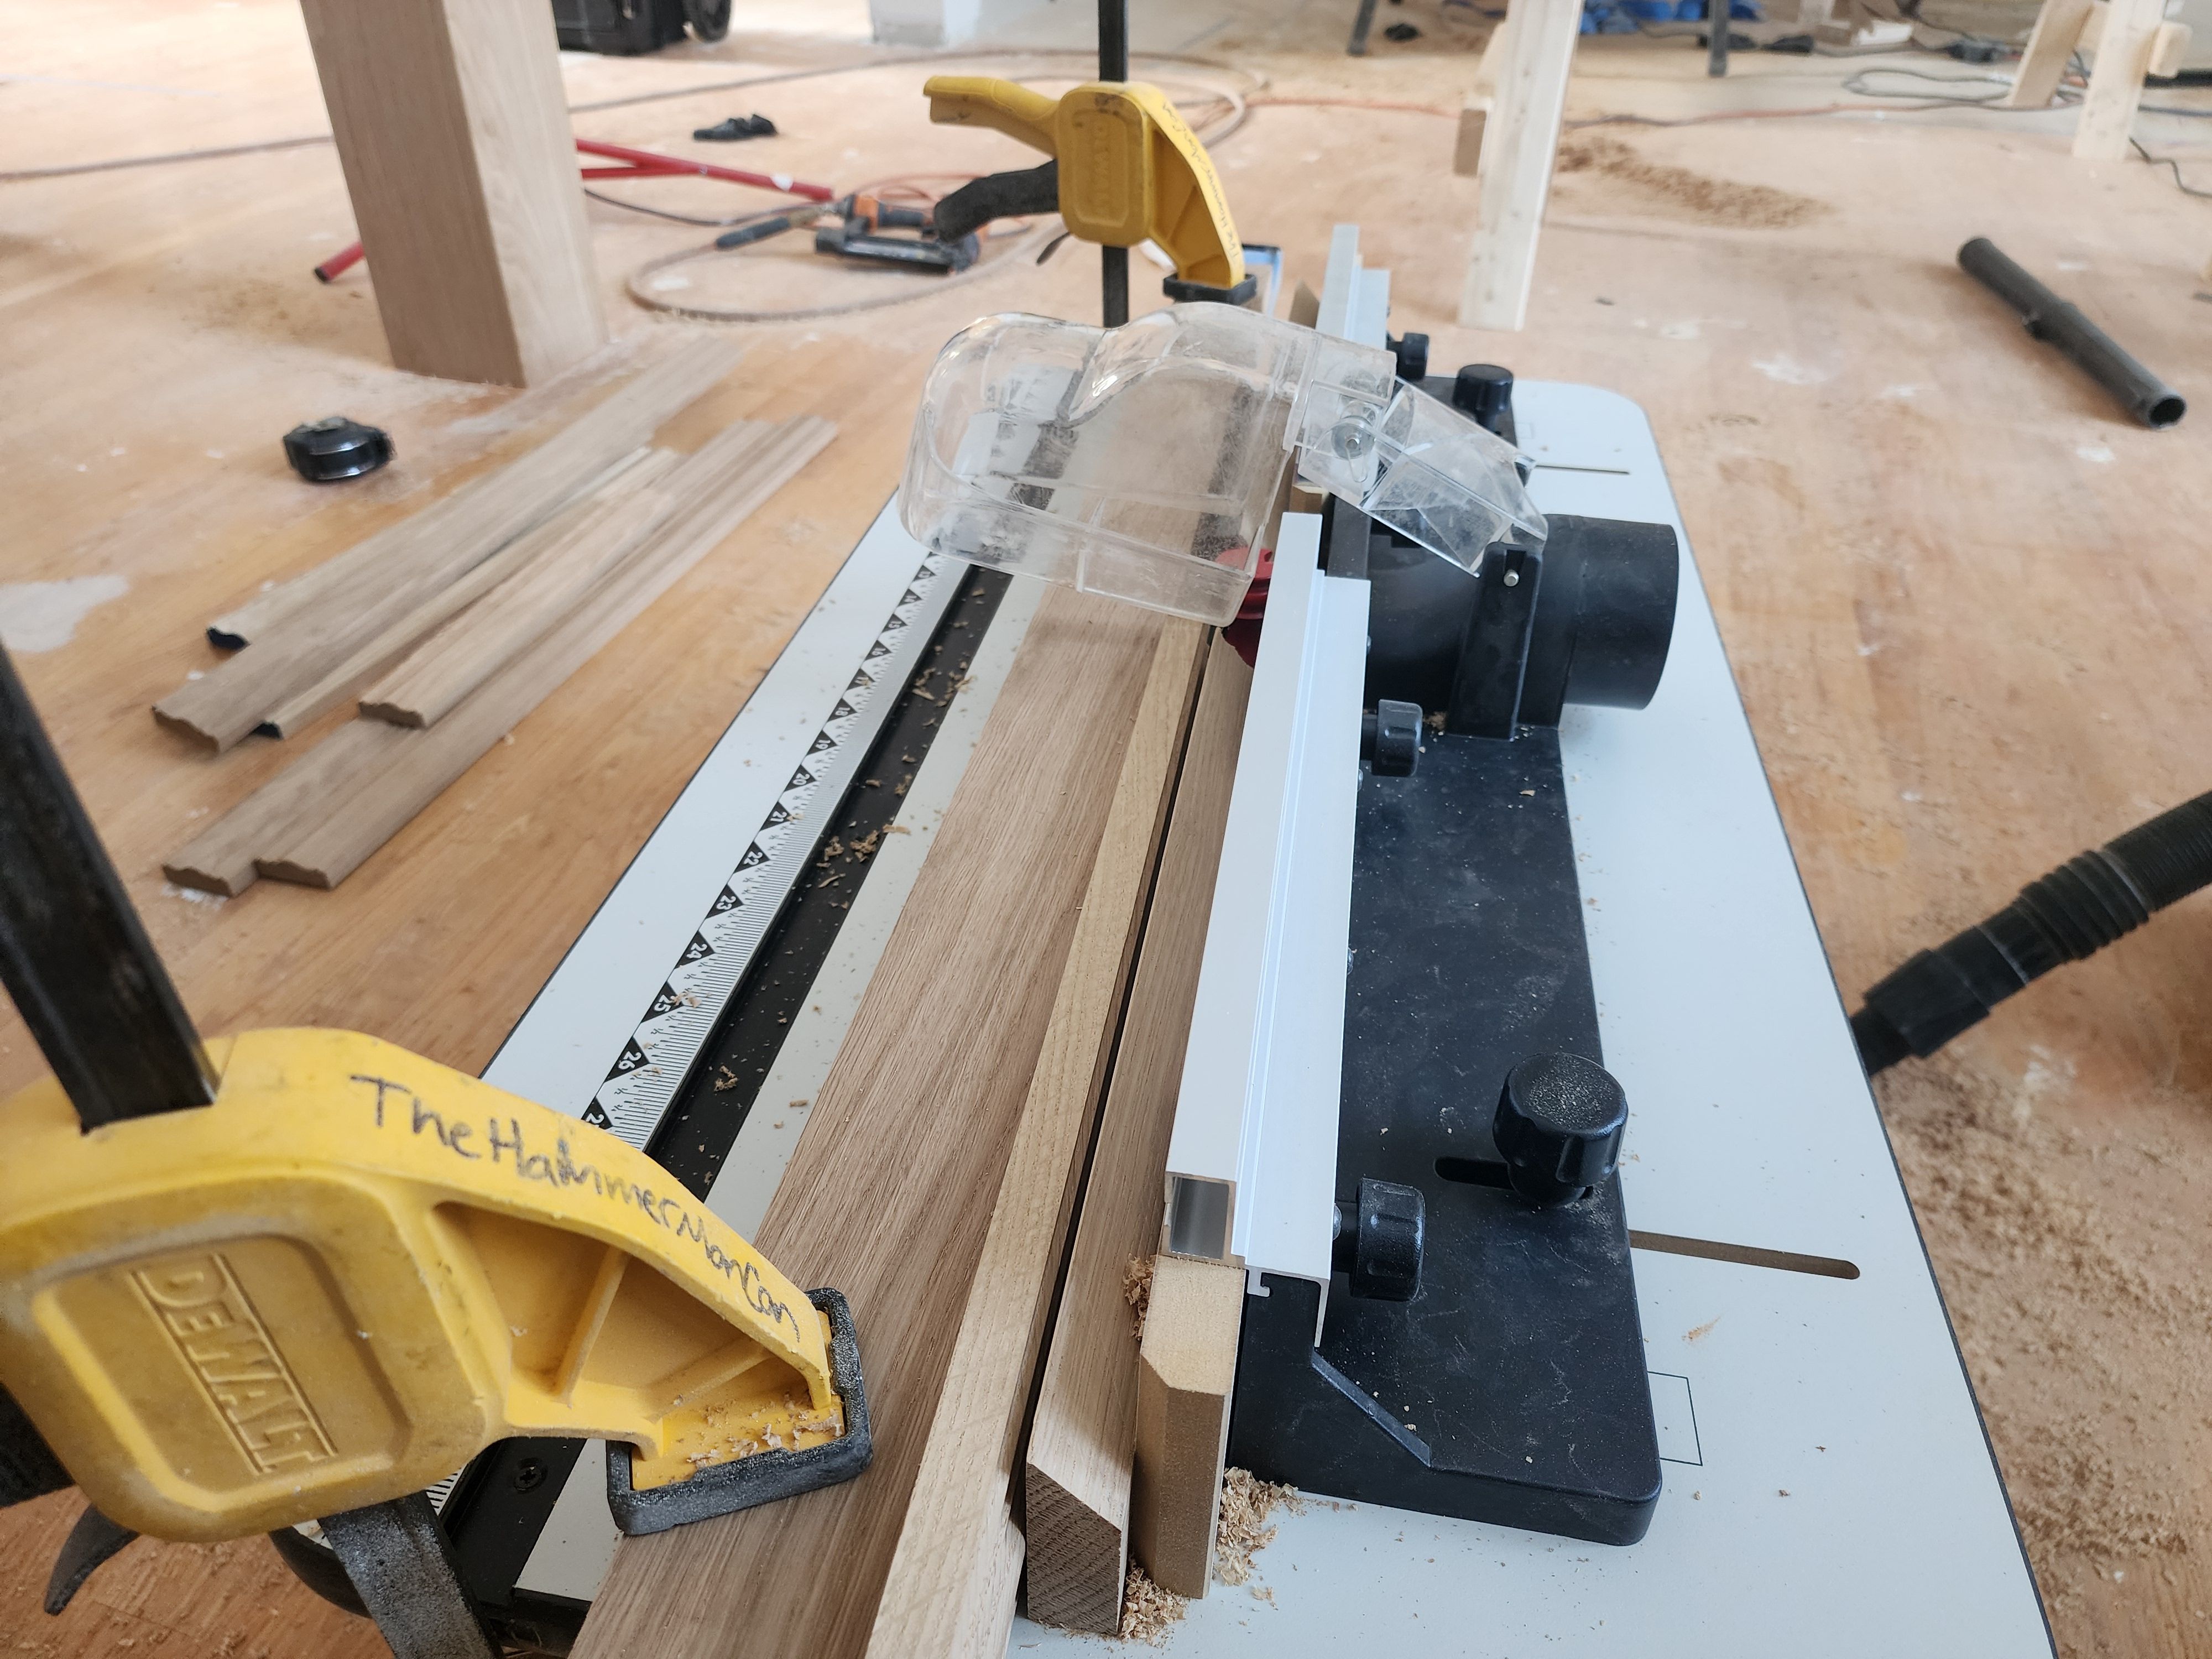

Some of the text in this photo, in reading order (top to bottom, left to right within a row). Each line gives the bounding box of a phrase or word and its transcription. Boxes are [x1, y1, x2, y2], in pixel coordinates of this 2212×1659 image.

[872, 648, 886, 656] 16
[835, 707, 851, 716] 18
[815, 740, 831, 749] 19
[792, 773, 810, 786] 20
[770, 811, 787, 822] 21
[744, 851, 763, 865] 22
[716, 895, 736, 910] 23
[686, 943, 707, 958] 24
[654, 994, 675, 1011] 25
[618, 1051, 641, 1070] 26
[586, 1113, 604, 1128] 2
